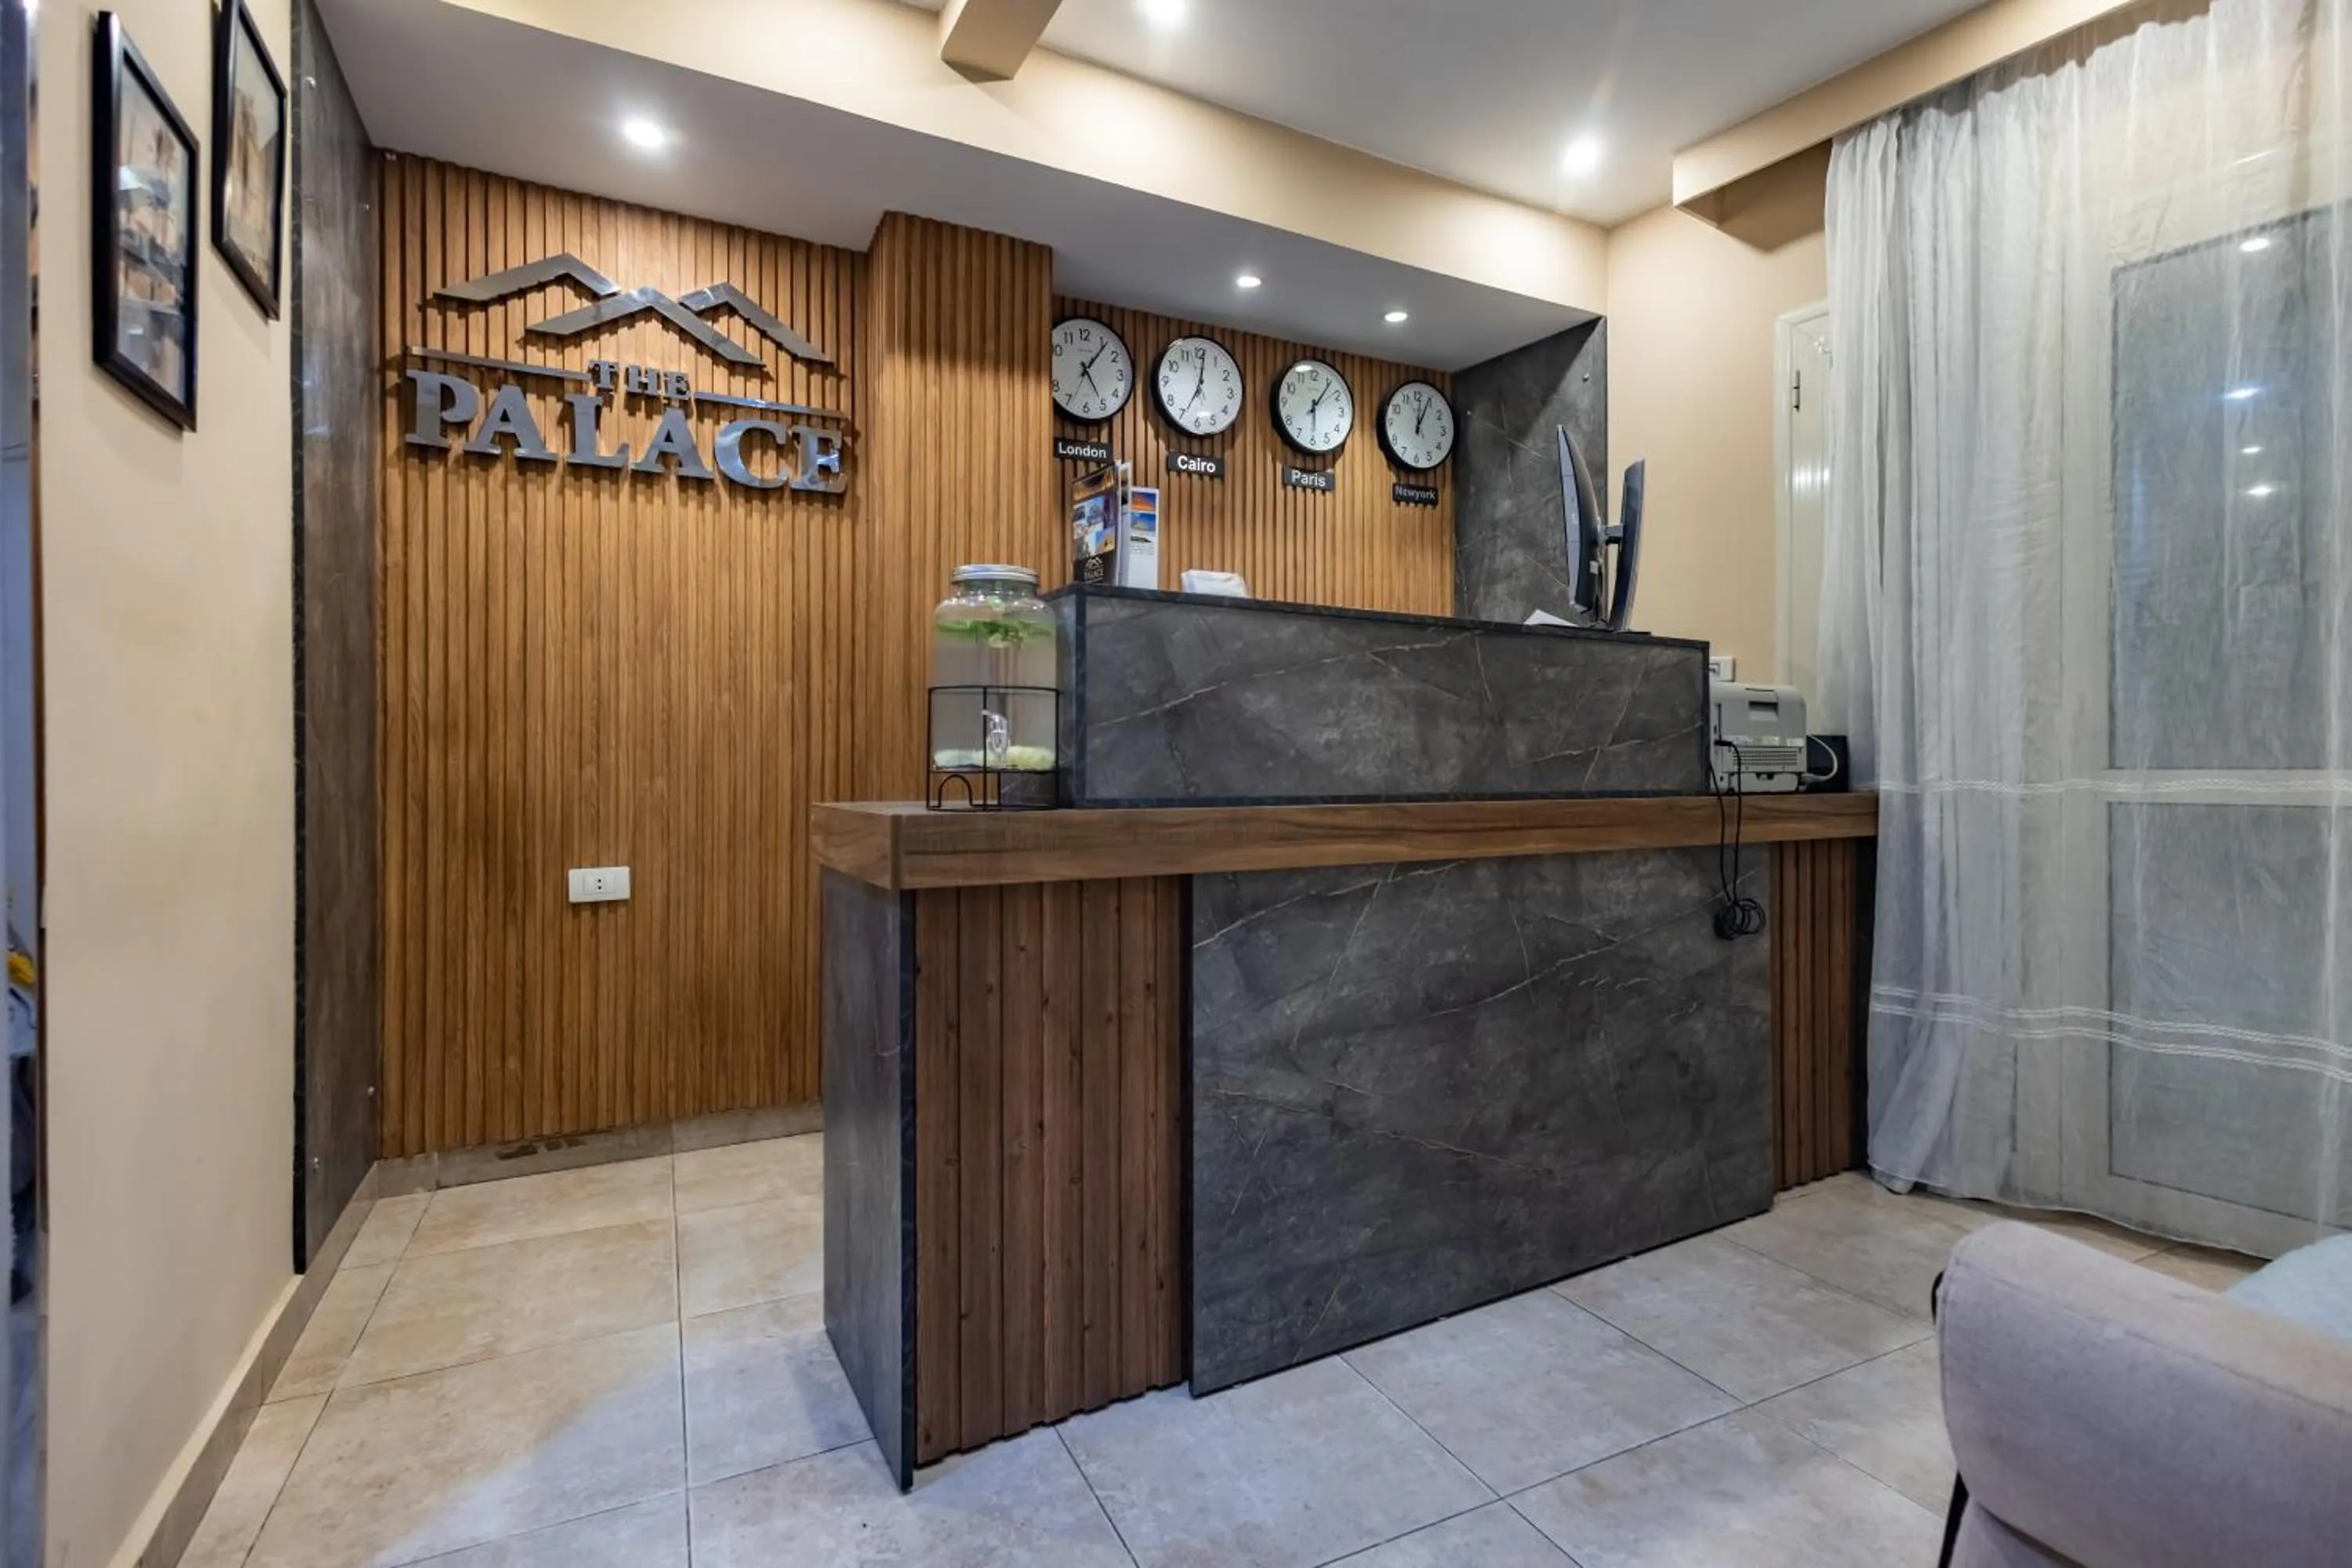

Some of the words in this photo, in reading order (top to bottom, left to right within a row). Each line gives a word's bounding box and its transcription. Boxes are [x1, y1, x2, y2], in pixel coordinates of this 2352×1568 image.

[1064, 331, 1073, 346] 11
[1079, 328, 1091, 341] 12
[1110, 350, 1119, 363] 2
[1181, 349, 1189, 362] 11
[1168, 360, 1179, 374] 10
[589, 359, 691, 400] THE
[1116, 369, 1123, 382] 3
[1161, 376, 1169, 388] 9
[1222, 369, 1230, 383] 2
[1112, 388, 1119, 399] 4
[1226, 387, 1235, 400] 3
[1287, 381, 1296, 394] 10
[1066, 393, 1073, 406] 7
[1167, 394, 1174, 407] 8
[1334, 390, 1341, 402] 2
[1414, 390, 1422, 402] 12
[1082, 401, 1091, 414] 6
[1099, 397, 1107, 412] 5
[1178, 407, 1185, 419] 7
[1338, 407, 1345, 419] 3
[1436, 408, 1443, 421] 2
[1193, 416, 1201, 429] 6
[1209, 414, 1217, 426] 5
[1285, 414, 1293, 426] 8
[405, 368, 848, 494] PALACE
[1296, 427, 1302, 439] 7
[1334, 424, 1340, 434] 4
[1440, 426, 1446, 437] 3
[1308, 434, 1316, 446] 6
[1323, 432, 1330, 445] 5
[1057, 441, 1107, 459] London
[1400, 446, 1406, 457] 7
[1177, 455, 1216, 473] Cairo
[1414, 453, 1420, 464] 6
[1290, 468, 1327, 487] Paris
